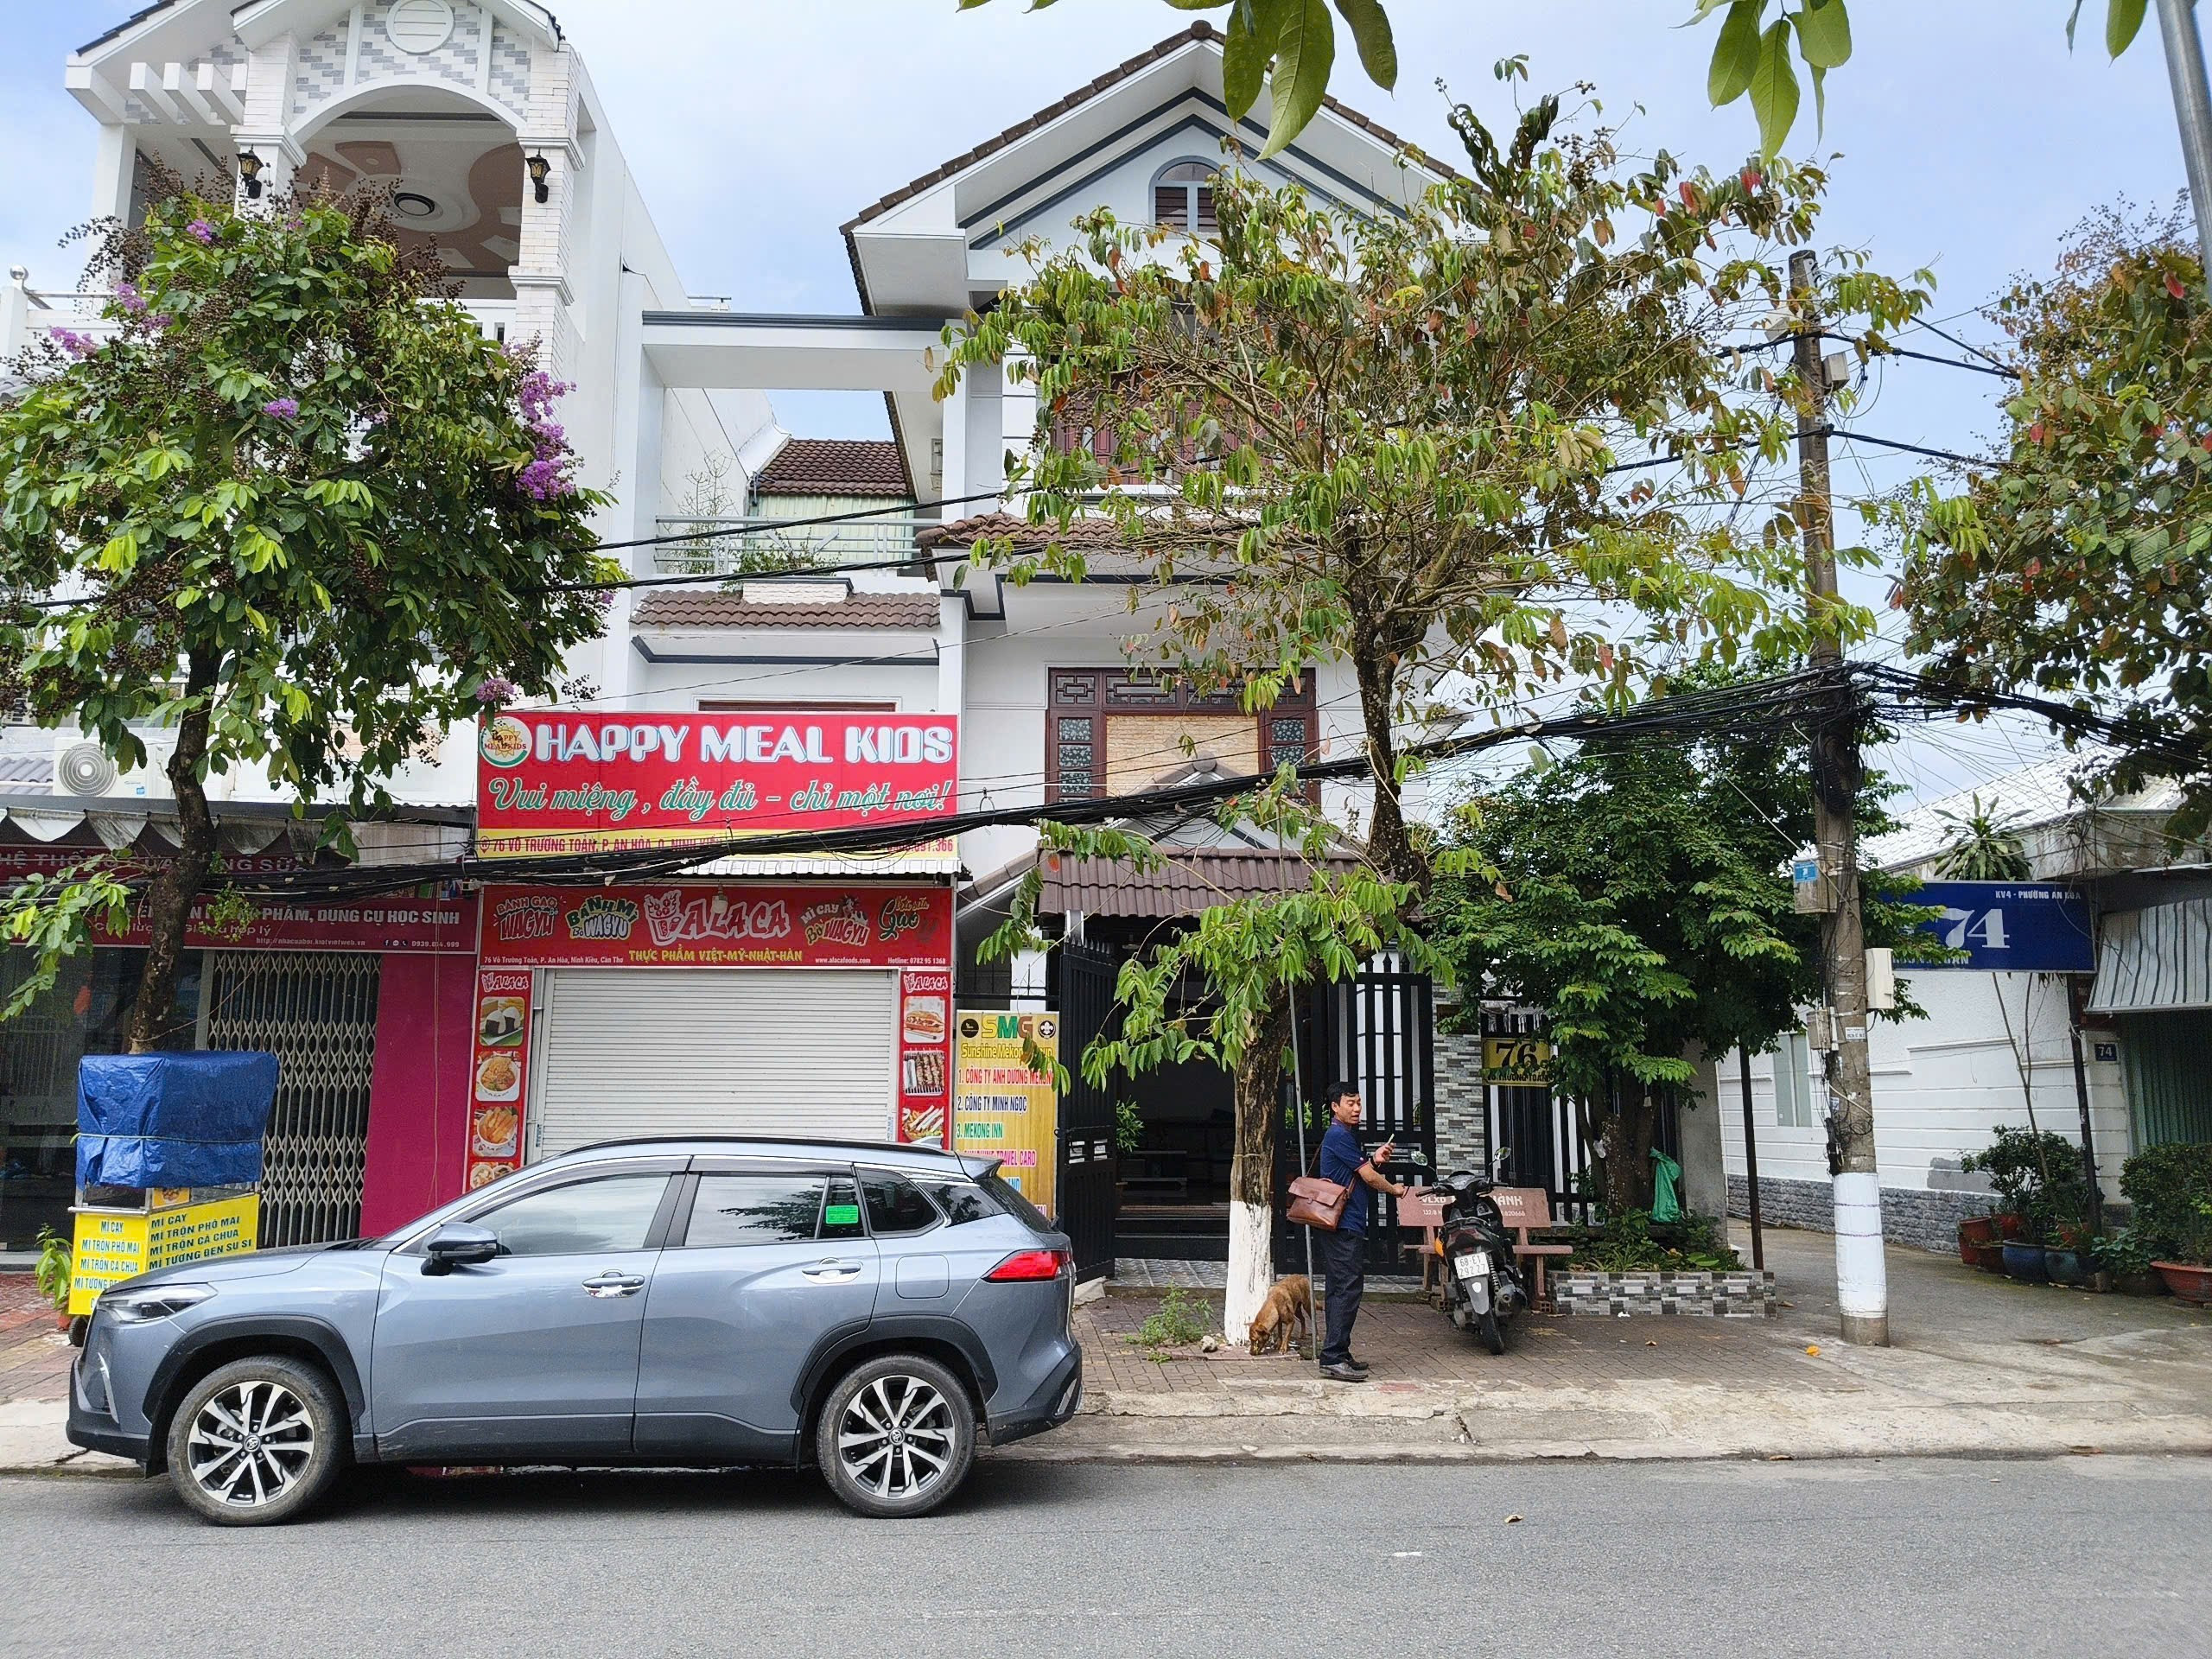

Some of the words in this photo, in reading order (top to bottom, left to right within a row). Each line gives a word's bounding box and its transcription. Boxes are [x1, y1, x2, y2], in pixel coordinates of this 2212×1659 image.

[536, 724, 690, 762] HAPPY
[701, 725, 833, 763] MEAL
[845, 727, 951, 763] KIDS
[489, 778, 547, 810] Vui
[550, 782, 637, 821] miệng
[660, 776, 715, 821] đầy
[719, 779, 758, 810] đủ
[790, 780, 833, 810] chỉ
[836, 783, 891, 817] một
[493, 839, 505, 851] 76
[614, 839, 627, 851] AN
[817, 903, 839, 916] CAY
[318, 910, 359, 925] DỤNG
[364, 910, 385, 925] CỤ
[387, 910, 418, 925] HỌC
[422, 911, 460, 925] SINH
[679, 899, 791, 939] ALACA
[584, 912, 629, 939] WAGYU
[823, 917, 870, 946] WAGYU
[1934, 907, 2010, 949] 74
[629, 949, 658, 963] THỰC
[662, 944, 695, 961] PHẨM
[982, 1015, 1033, 1039] SMG
[961, 1043, 997, 1058] Sunshine
[1496, 1043, 1538, 1069] 76
[2098, 1046, 2113, 1057] 74
[965, 1065, 982, 1084] CÔNG
[984, 1070, 991, 1084] TY
[957, 1096, 963, 1111] 2.
[965, 1092, 982, 1111] CÔNG
[983, 1096, 990, 1111] TY
[992, 1096, 1008, 1111] MINH
[1010, 1096, 1027, 1115] NGỌC
[957, 1123, 963, 1138] 3.
[964, 1123, 990, 1138] MEKONG
[991, 1123, 1003, 1138] INN
[1020, 1150, 1036, 1166] CARD
[168, 1213, 188, 1225] CAY
[220, 1216, 240, 1227] MAI
[111, 1221, 124, 1233] CAY
[213, 1229, 239, 1242] CHUA
[127, 1242, 139, 1253] MAI
[226, 1241, 238, 1252] SU
[241, 1238, 251, 1249] SI
[121, 1261, 138, 1273] CHUA
